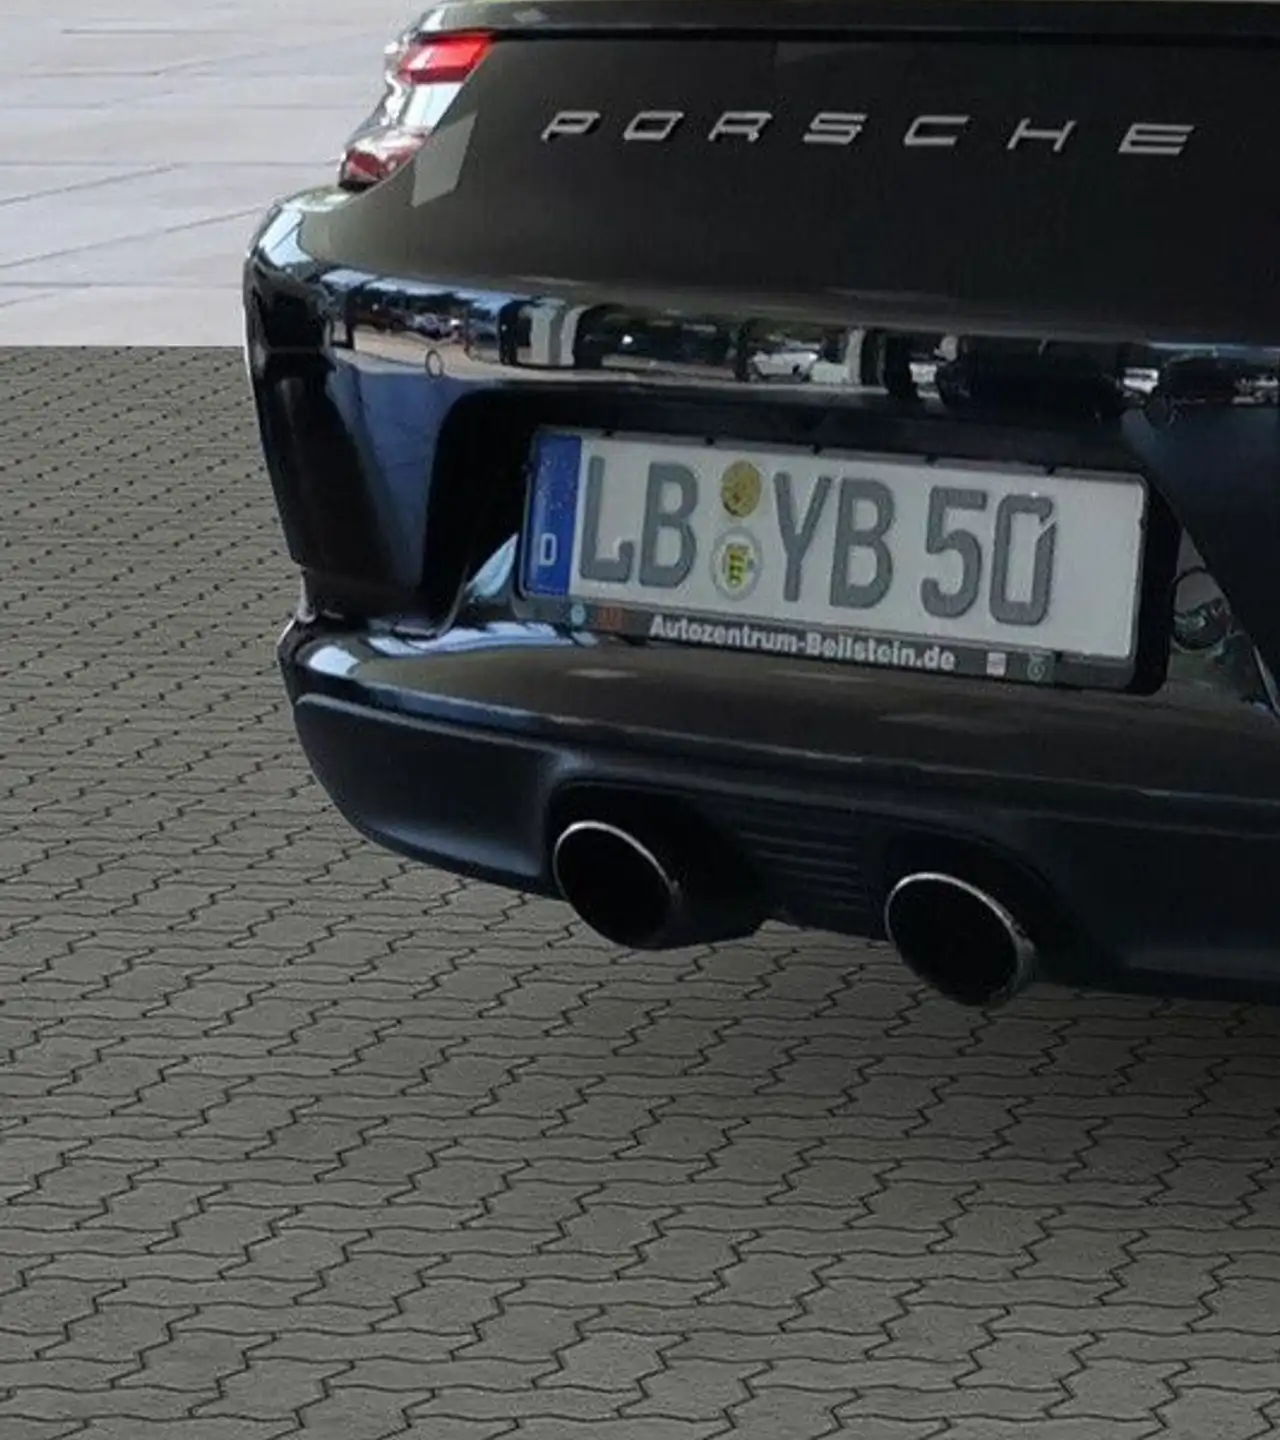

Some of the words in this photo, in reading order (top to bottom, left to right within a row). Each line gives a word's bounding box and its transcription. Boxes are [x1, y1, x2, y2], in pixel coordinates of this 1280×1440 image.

[541, 111, 1195, 155] PORSCHE
[579, 456, 698, 588] LB
[773, 472, 895, 609] YB
[649, 614, 957, 673] Autozentrum-Beilstein.de
